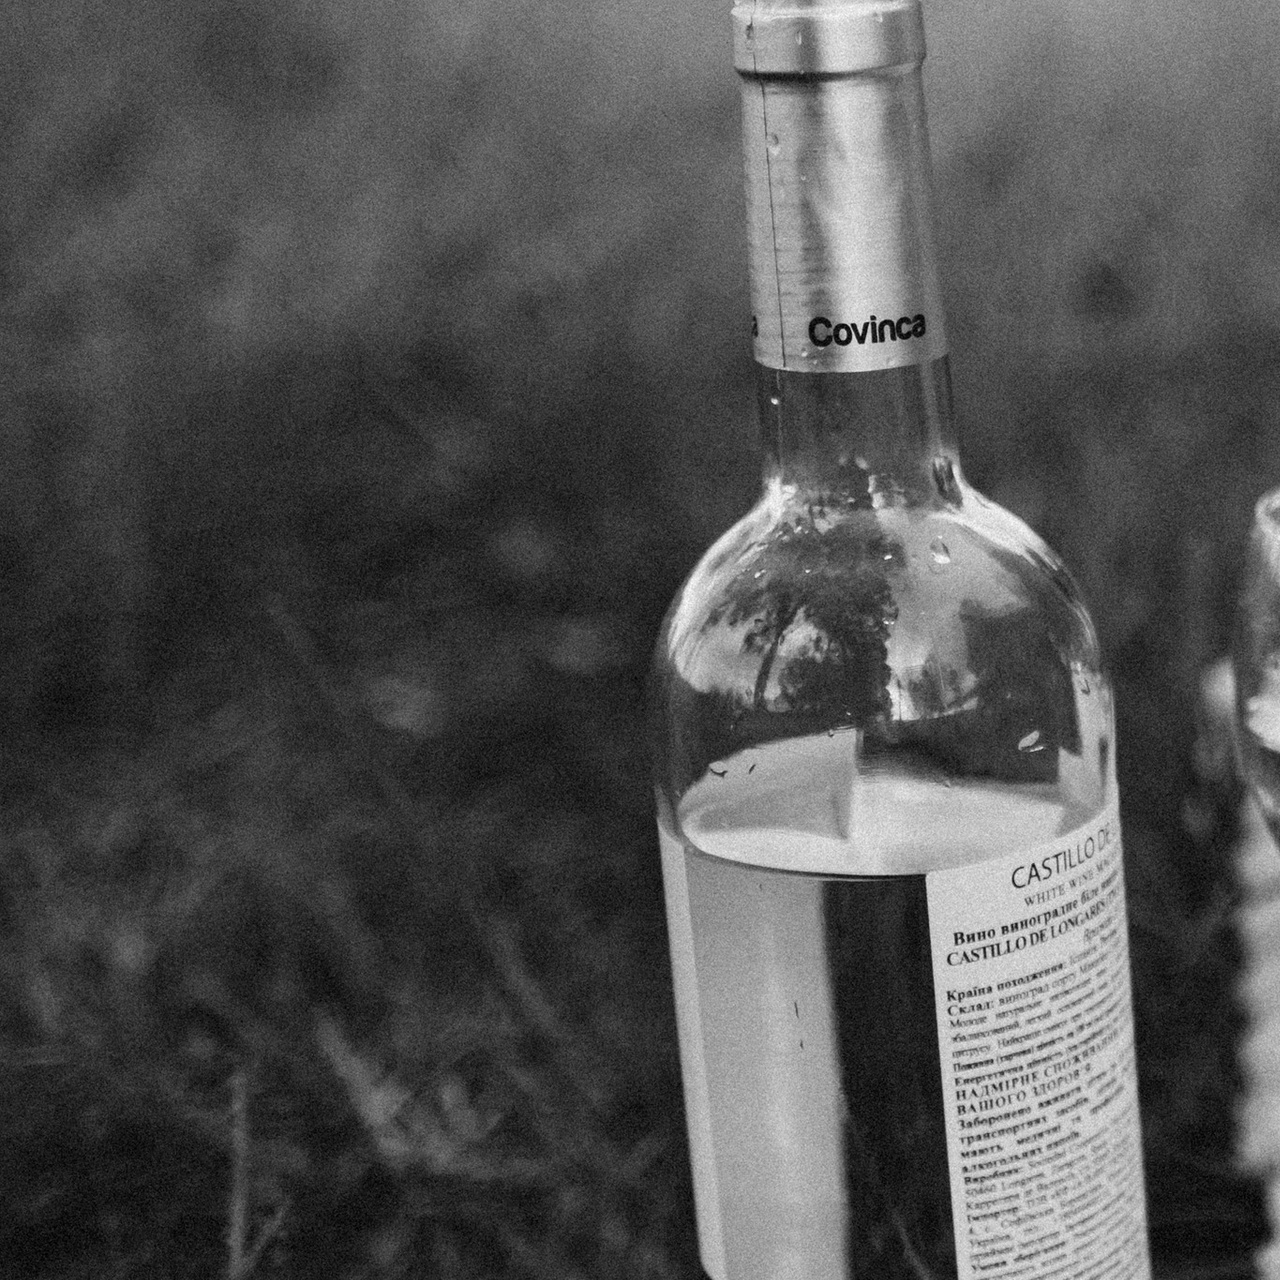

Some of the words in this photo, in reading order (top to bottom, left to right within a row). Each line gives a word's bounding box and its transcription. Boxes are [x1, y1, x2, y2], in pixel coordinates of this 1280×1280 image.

[808, 314, 926, 348] Covinca
[1011, 836, 1095, 889] CASTILLO
[1024, 883, 1066, 907] WHITE
[953, 926, 996, 947] Вино
[1001, 899, 1078, 936] виноградне
[946, 935, 1027, 967] CASTILLO
[1029, 928, 1049, 947] DE
[946, 983, 993, 1003] Країна
[955, 1071, 1039, 1102] НАДМІРНЕ
[957, 1089, 1027, 1117] ВАШОГО
